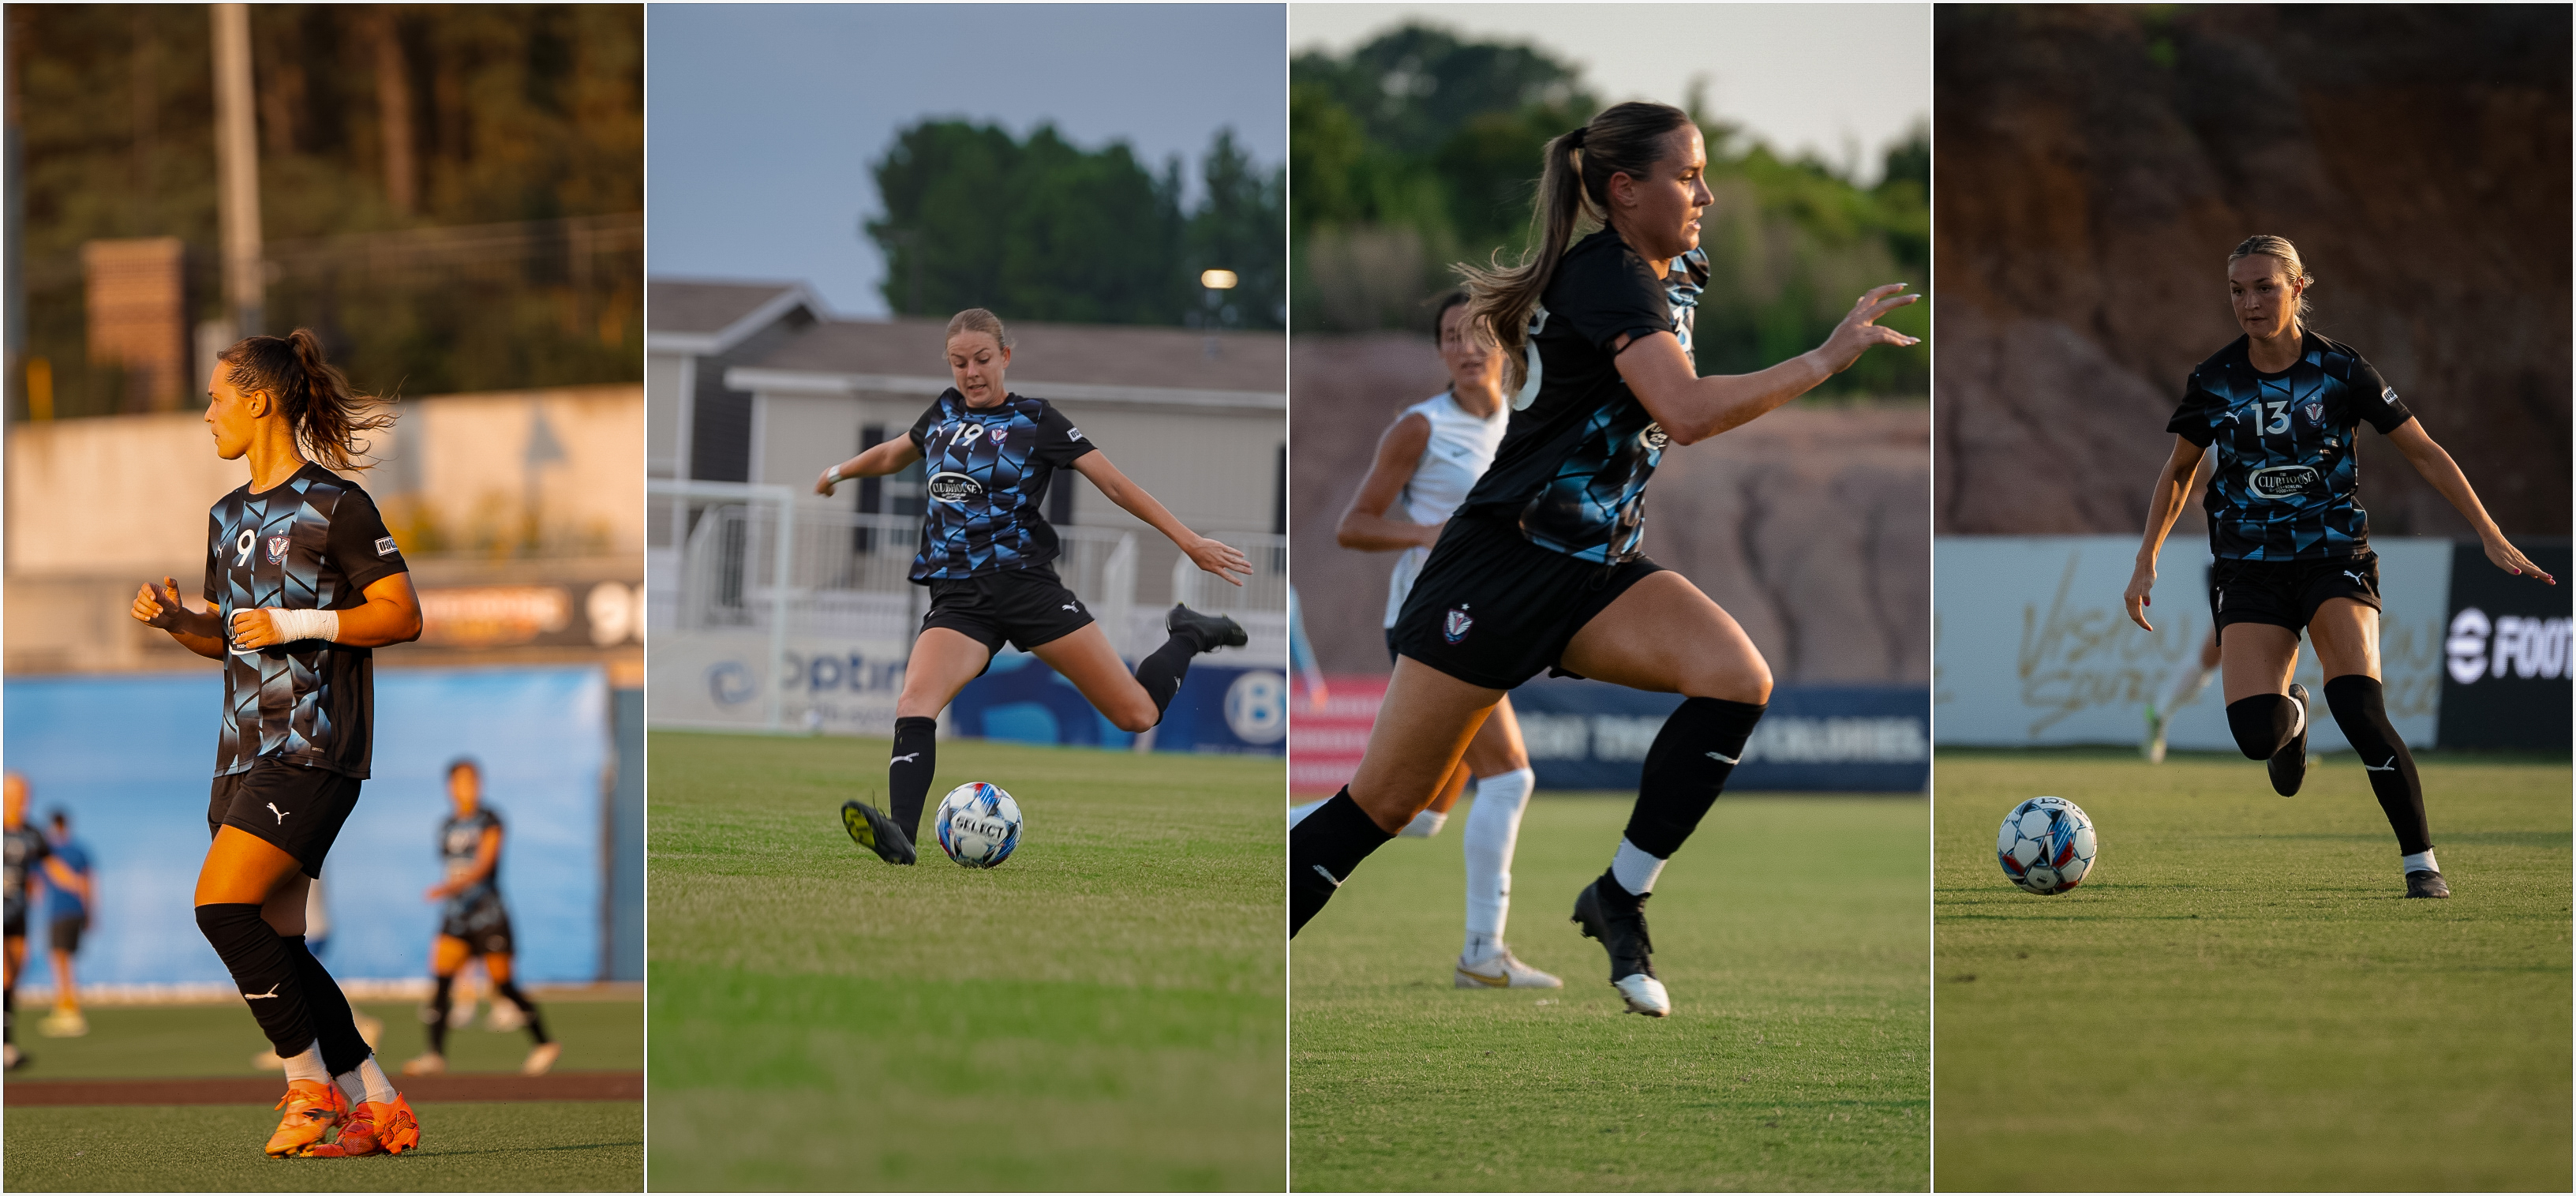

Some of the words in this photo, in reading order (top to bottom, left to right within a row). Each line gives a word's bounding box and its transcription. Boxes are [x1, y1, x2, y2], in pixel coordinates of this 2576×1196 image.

[2251, 400, 2290, 436] 13
[949, 422, 984, 447] 19
[932, 482, 977, 494] CLUBHOUSE
[2258, 471, 2314, 488] CLUBHOUSE
[237, 528, 256, 567] 9
[955, 816, 1004, 840] SELECT
